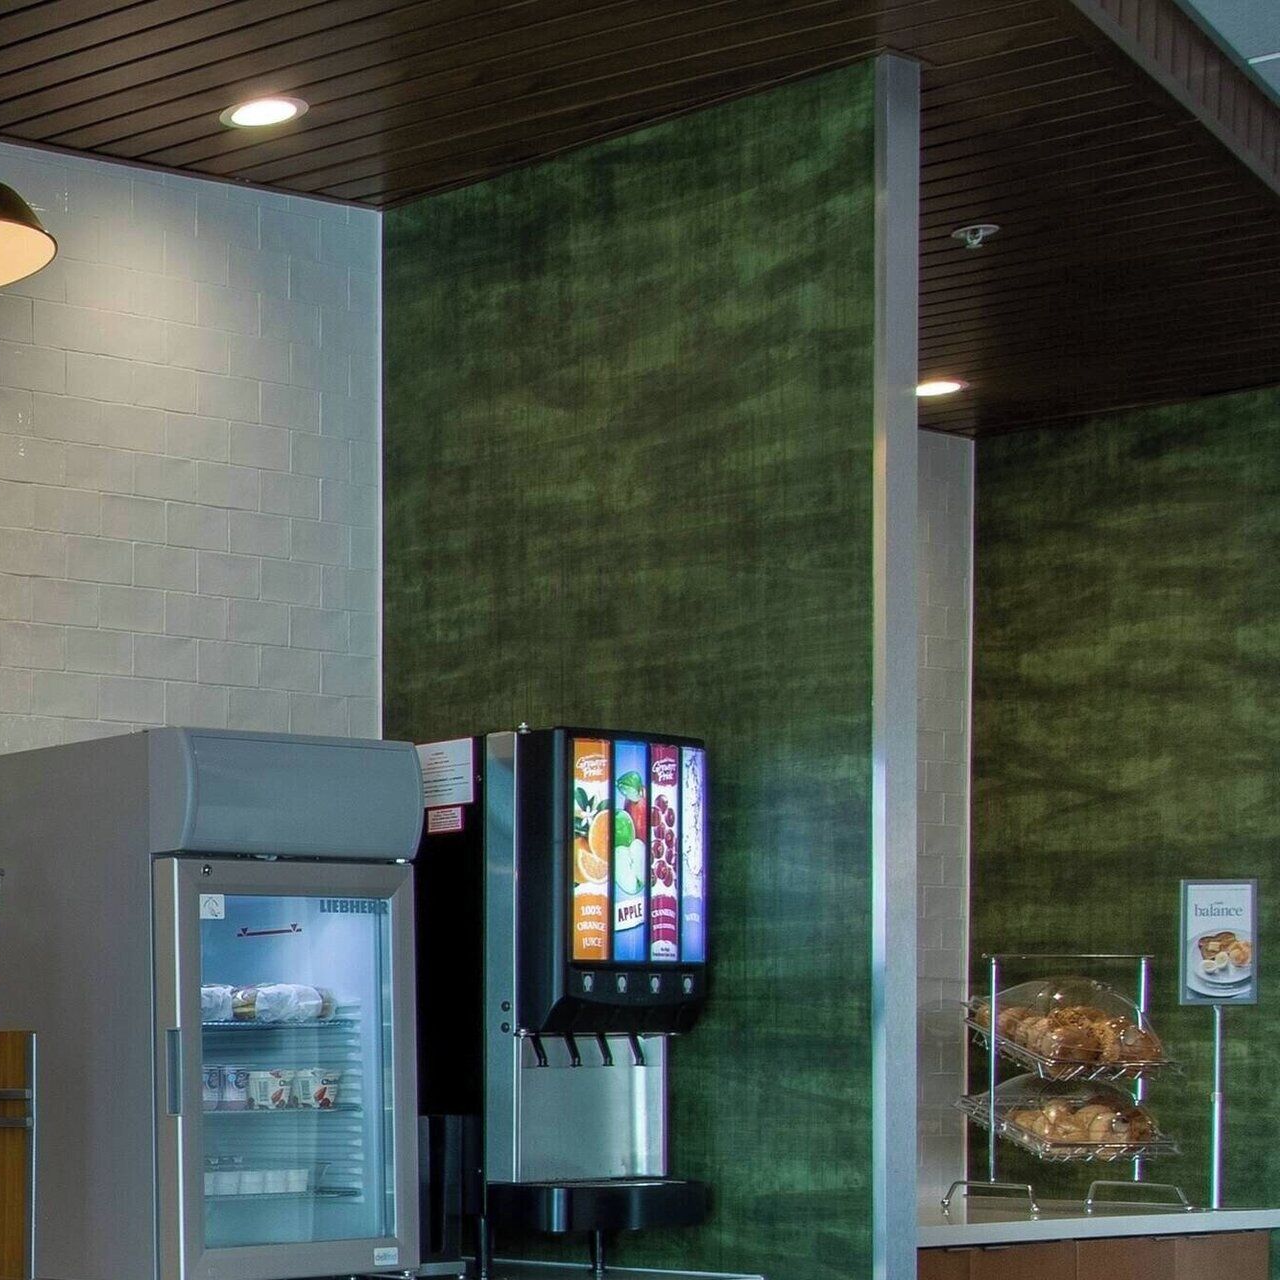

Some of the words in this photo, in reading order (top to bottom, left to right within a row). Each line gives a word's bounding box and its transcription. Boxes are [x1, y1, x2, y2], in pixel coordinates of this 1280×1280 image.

[320, 899, 388, 915] LIEBHERR
[581, 904, 602, 917] 100%
[618, 902, 643, 923] APPLE
[1194, 903, 1244, 917] balance
[577, 921, 606, 932] ORANGE
[582, 936, 603, 949] JUICE
